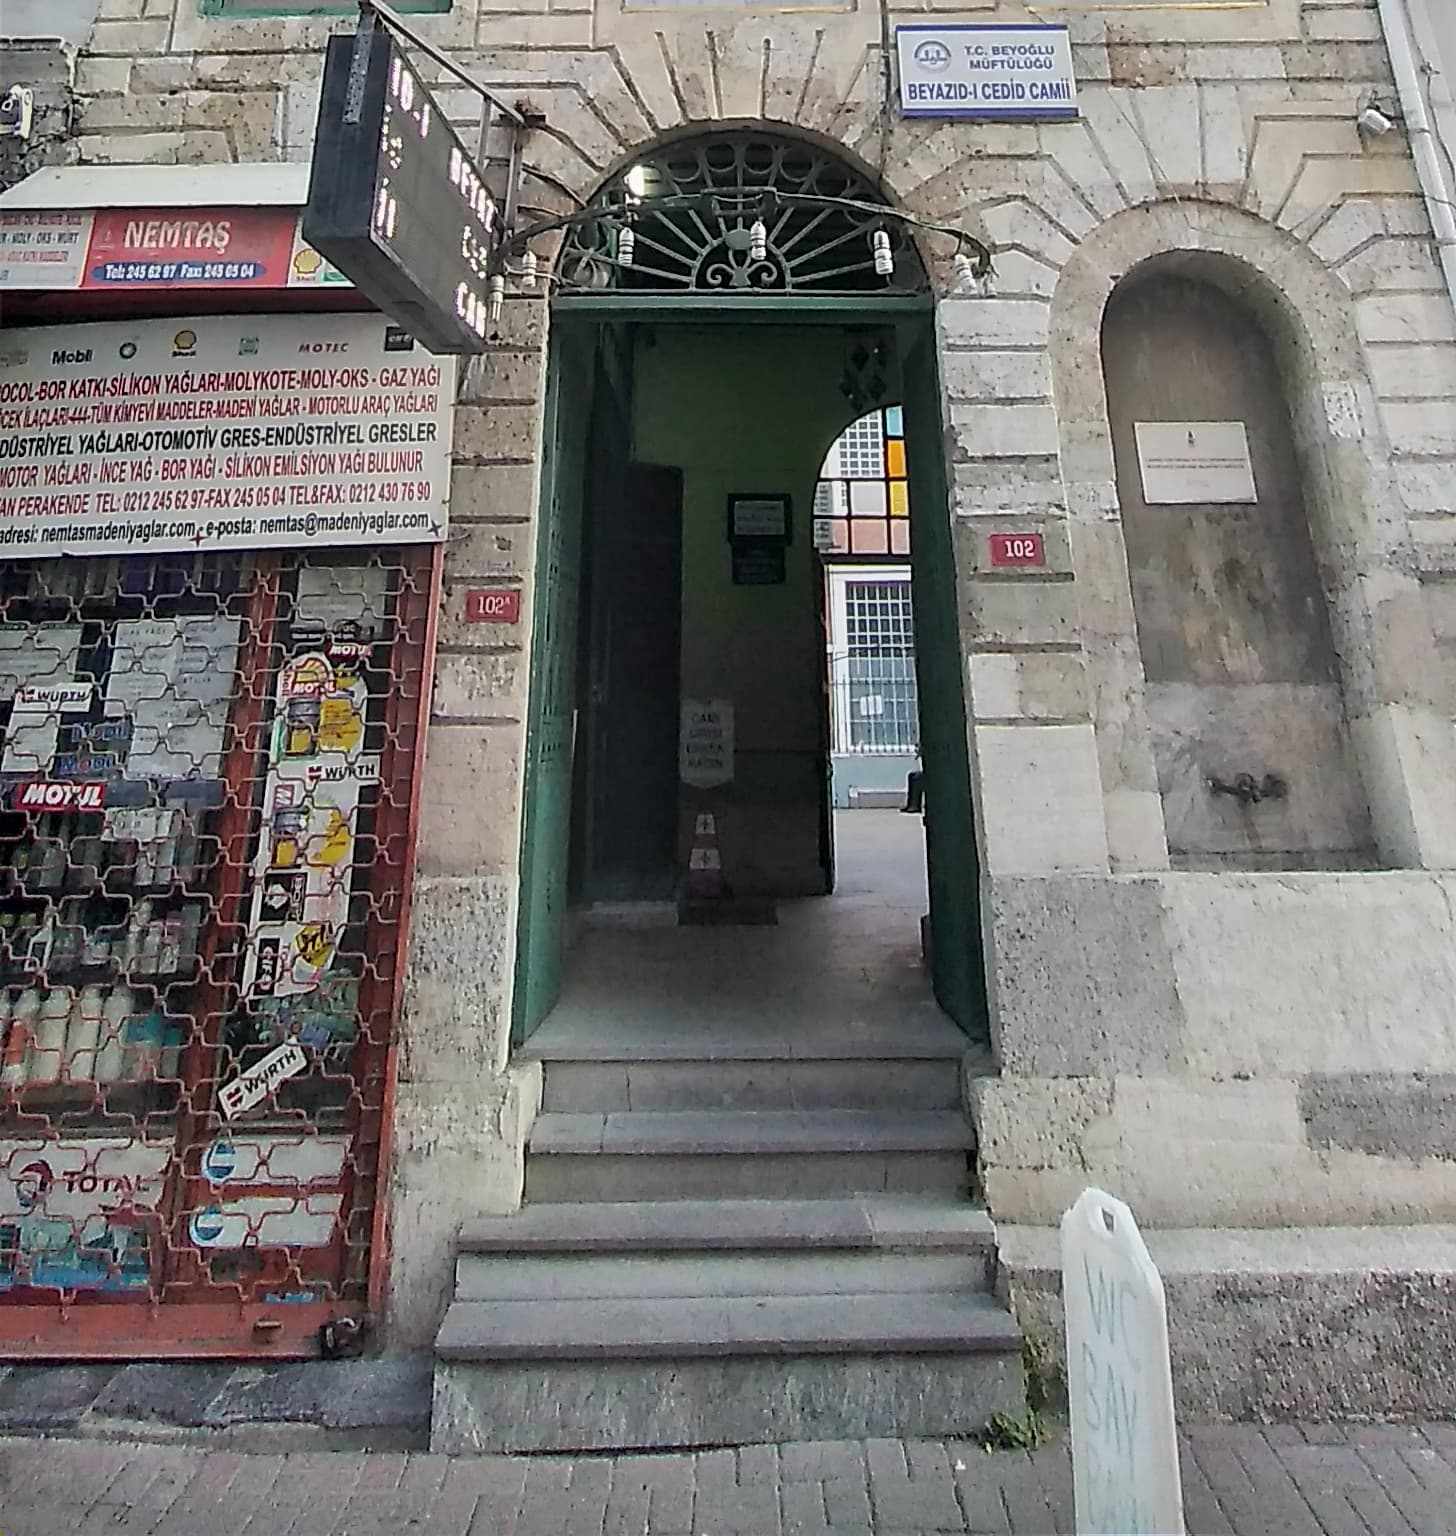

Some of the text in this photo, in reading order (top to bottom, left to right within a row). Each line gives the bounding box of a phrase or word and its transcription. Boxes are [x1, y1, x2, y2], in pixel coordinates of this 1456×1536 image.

[964, 43, 1055, 56] T.C. BEYOĞLU
[969, 57, 1053, 70] MÜFTÜLÜĞÜ
[908, 82, 978, 100] BEYAZID-I
[982, 78, 1026, 100] CEDİD
[124, 220, 232, 255] NEMTAŞ
[126, 265, 146, 279] 245
[148, 265, 161, 279] 62
[162, 265, 177, 279] 97
[180, 264, 202, 279] Fax:
[203, 264, 223, 279] 245
[225, 264, 239, 278] 05
[240, 264, 255, 278] 04
[52, 349, 93, 364] Mobil
[299, 343, 349, 353] MOTEC
[0, 379, 67, 403] OCOL-BOR
[379, 367, 408, 387] GAZ
[410, 363, 441, 387] YAĞI
[0, 408, 21, 429] CEK
[114, 398, 155, 423] KİMYEVİ
[259, 394, 301, 417] YAĞLAR
[308, 396, 360, 415] MOTORLU
[361, 394, 391, 418] ARAÇ
[393, 390, 438, 413] YAĞLARI
[78, 424, 219, 455] YAĞLARI-OTOMOTİV
[220, 421, 365, 449] GRES-ENDÜSTRİYEL
[368, 422, 437, 444] GRESLER
[44, 459, 94, 486] YAĞLARI
[100, 457, 128, 483] İNCE
[130, 455, 153, 482] YAĞ
[161, 458, 188, 480] BOR
[189, 453, 217, 479] YAĞI
[224, 451, 272, 479] SİLİKON
[339, 448, 366, 474] YAĞI
[367, 451, 424, 474] BULUNUR
[0, 497, 17, 517] AN
[17, 493, 91, 516] PERAKENDE
[96, 492, 121, 513] TEL:
[123, 490, 151, 513] 0212
[152, 490, 174, 511] 245
[174, 489, 189, 510] 62
[233, 487, 255, 508] 245
[256, 486, 271, 507] 05
[272, 485, 287, 506] 04
[289, 482, 346, 505] TEL&FAX:
[349, 483, 377, 503] 0212
[378, 482, 399, 503] 430
[401, 482, 415, 502] 76
[417, 480, 432, 501] 90
[41, 518, 196, 544] nemtasmadeniyaglar.com
[206, 516, 257, 540] e-posta:
[259, 509, 429, 537] nemtas@madeniyaglar.com
[1005, 540, 1035, 558] 102
[1082, 1250, 1138, 1369] WC
[1081, 1339, 1138, 1482] BAY
